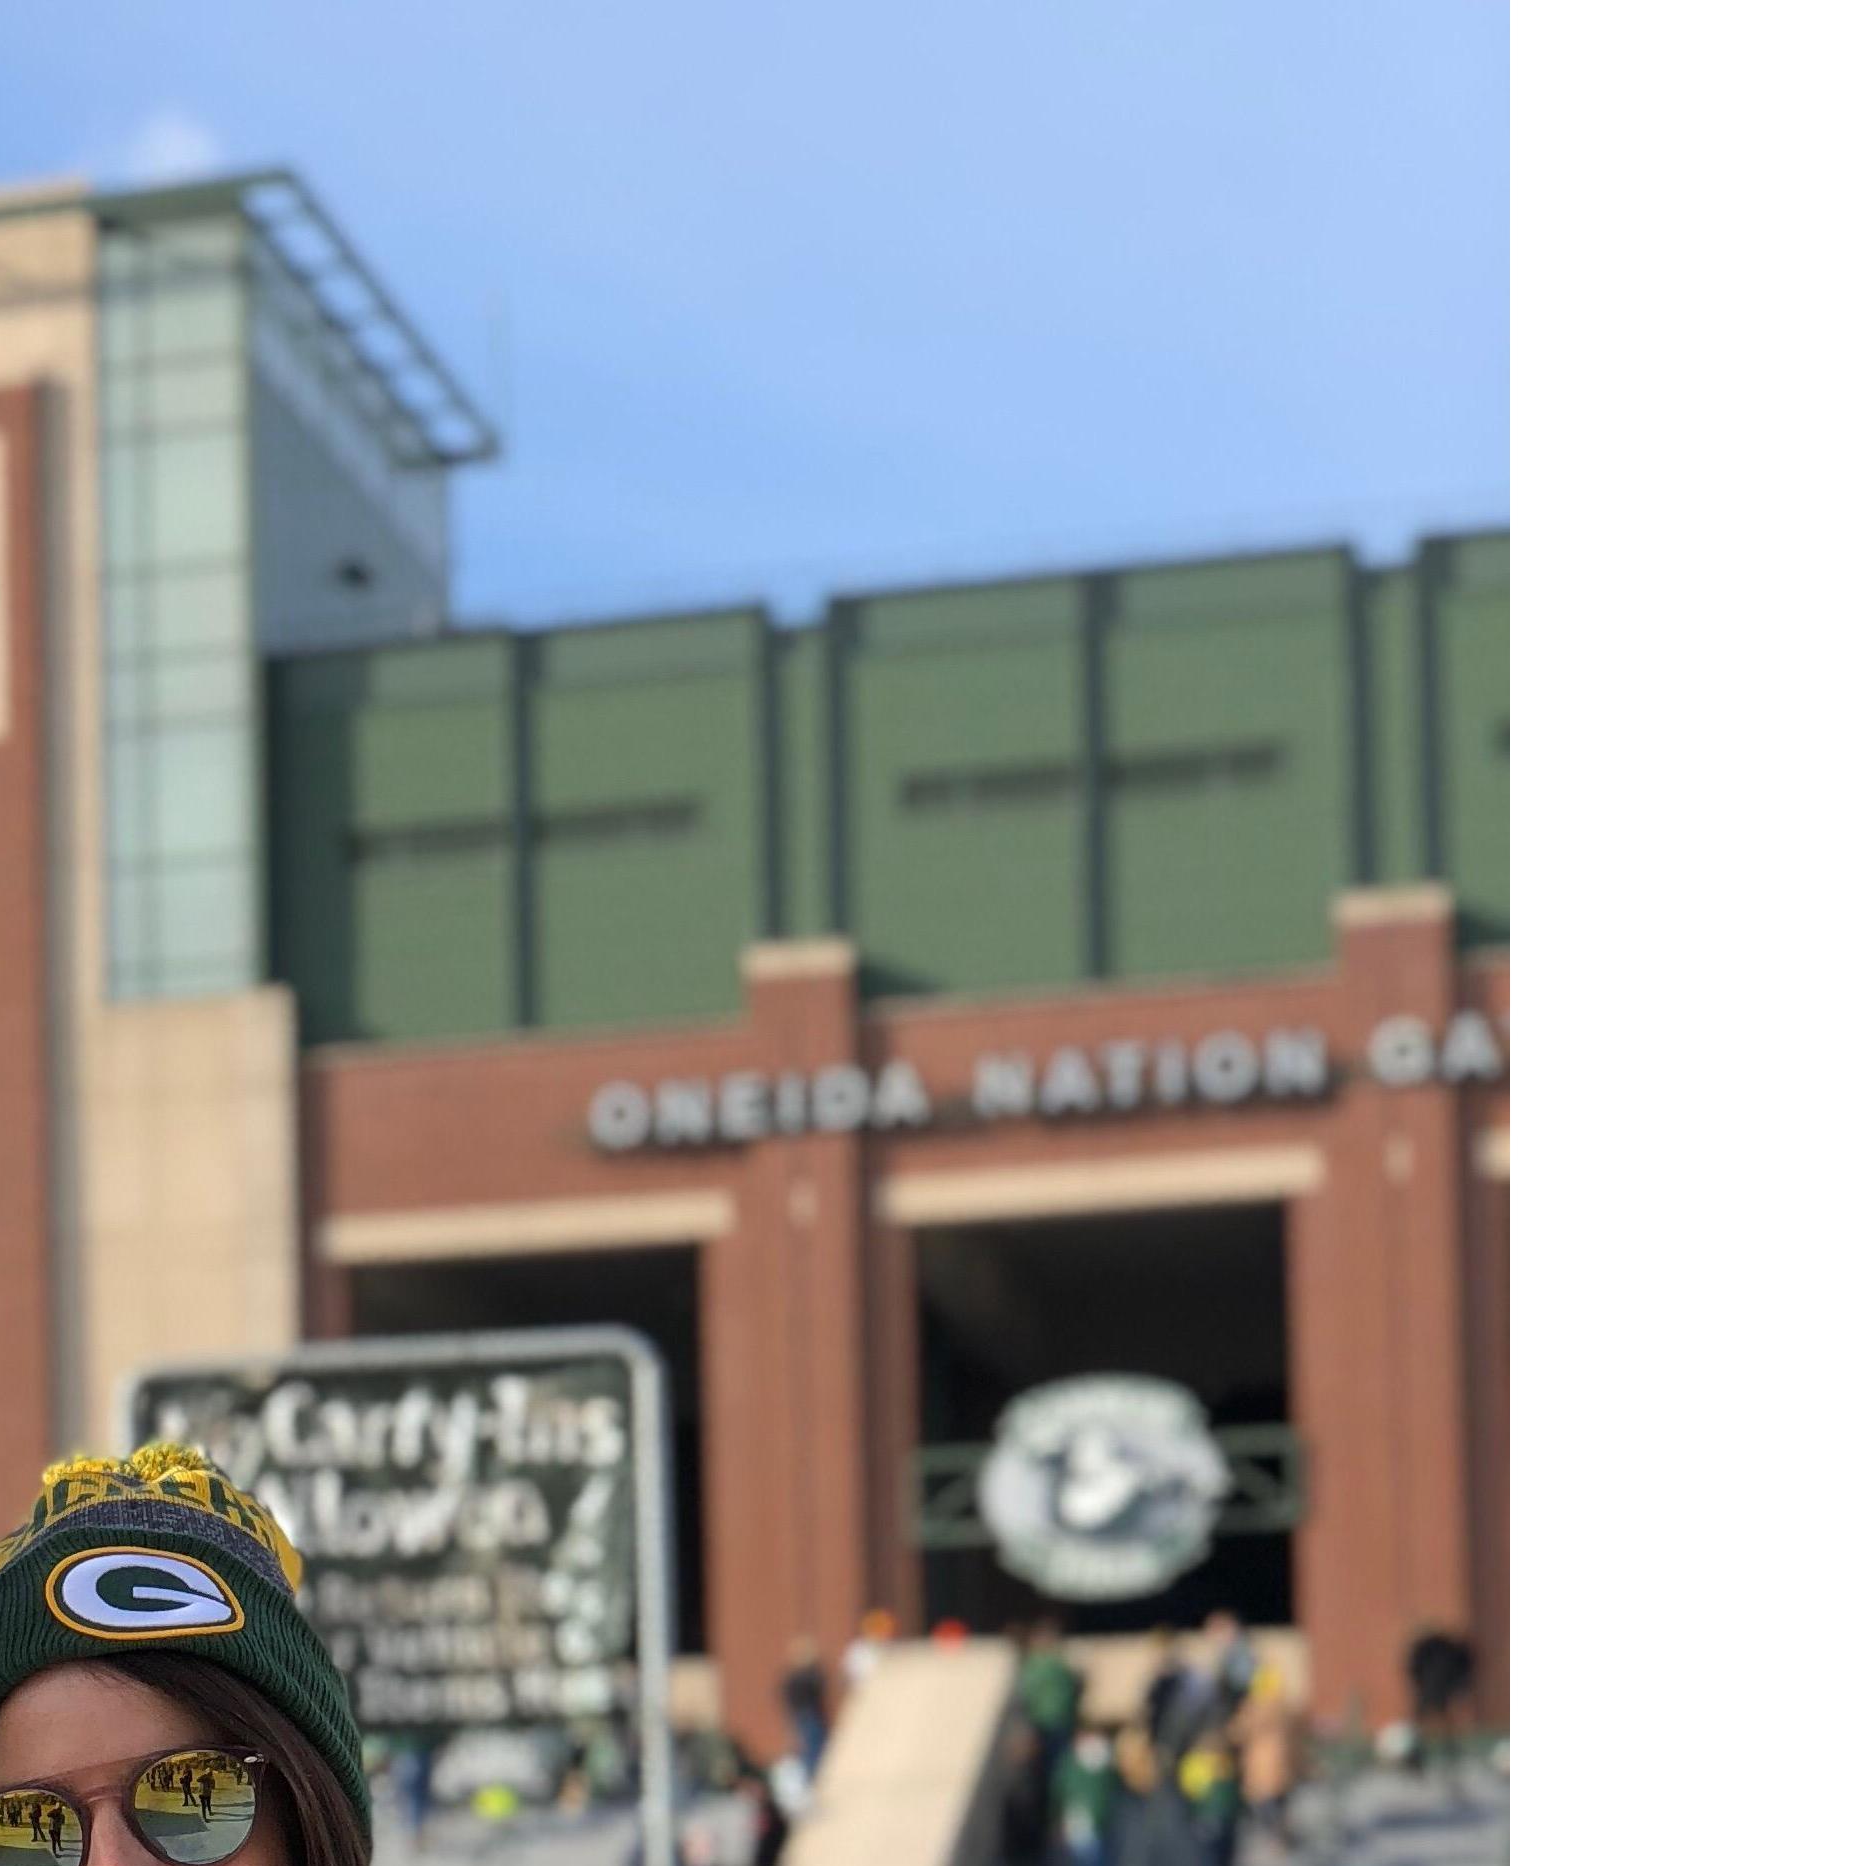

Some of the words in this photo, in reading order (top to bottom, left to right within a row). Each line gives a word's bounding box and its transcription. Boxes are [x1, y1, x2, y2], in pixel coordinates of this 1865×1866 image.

[587, 1060, 928, 1150] ONEIDA
[973, 1027, 1329, 1118] NATION
[1367, 1009, 1510, 1087] GA
[57, 1551, 237, 1631] G
